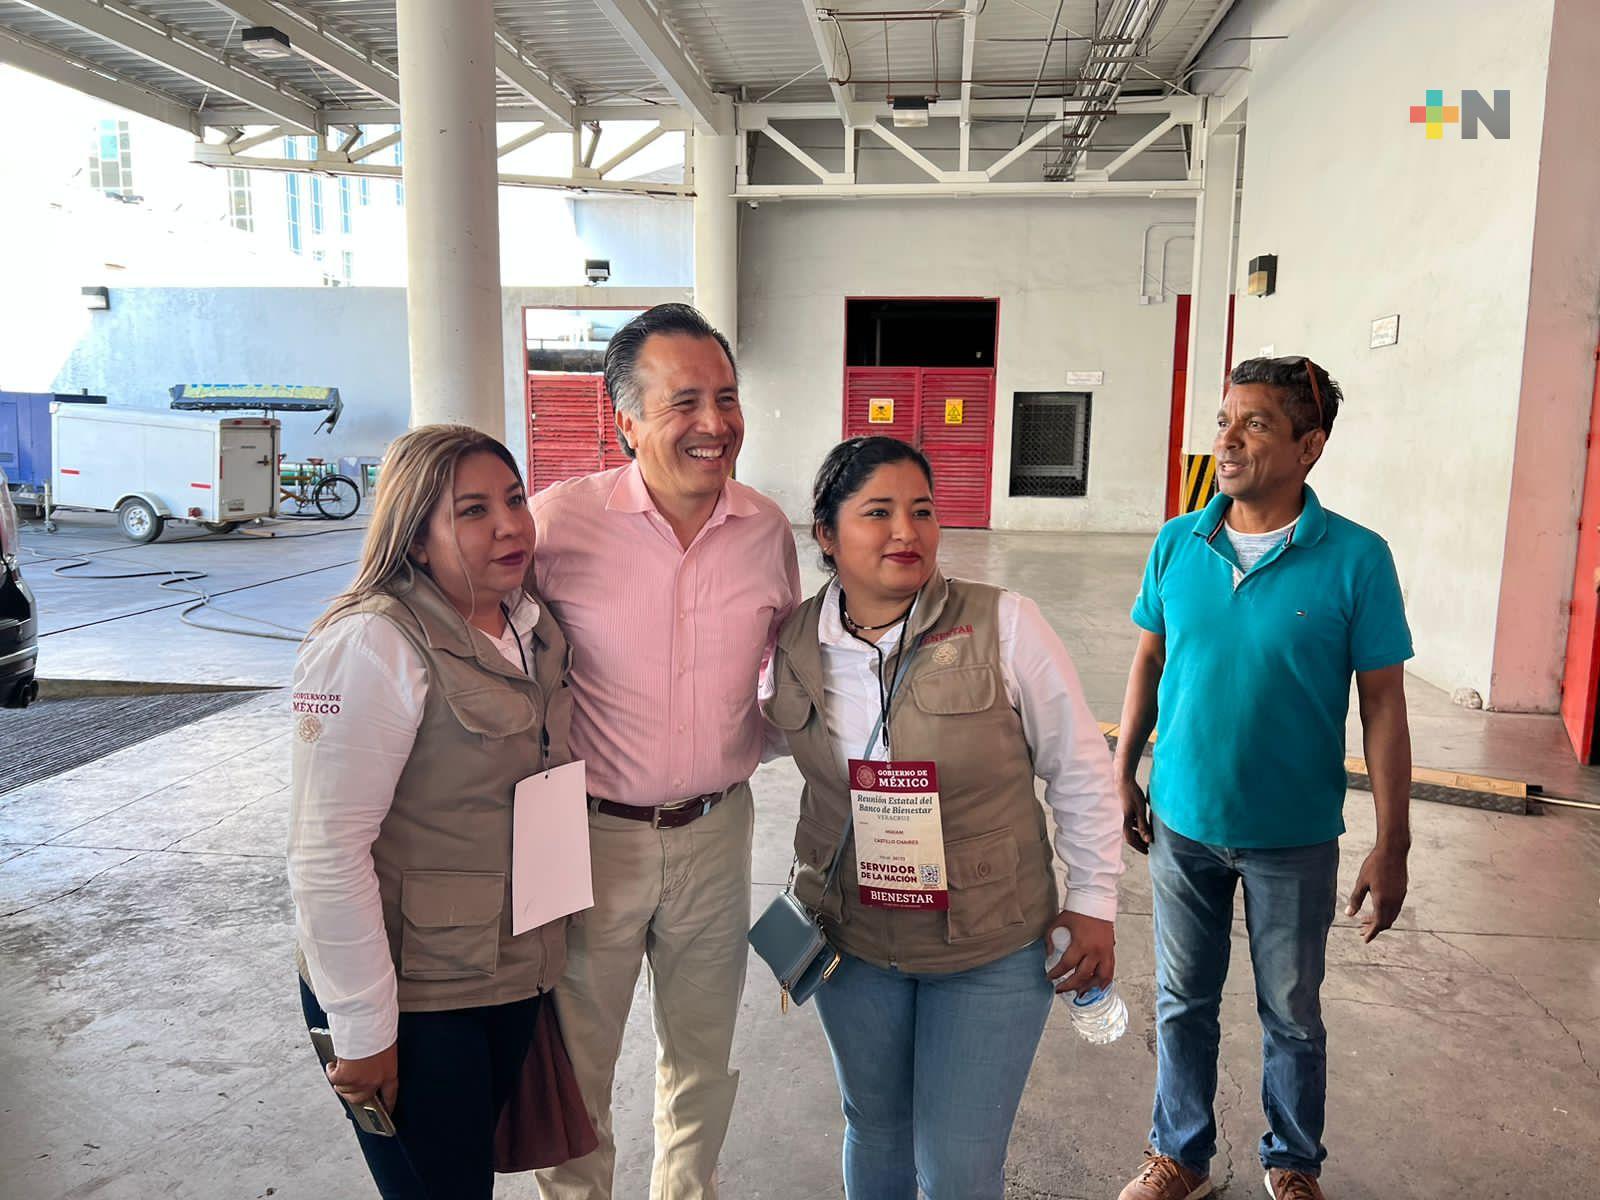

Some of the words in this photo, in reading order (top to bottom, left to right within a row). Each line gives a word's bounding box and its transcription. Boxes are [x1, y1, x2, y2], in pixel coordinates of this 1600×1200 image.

[293, 692, 327, 701] GOBIERNO
[293, 700, 340, 714] MÉXICO
[879, 775, 929, 788] MÉXICO
[888, 796, 918, 805] Estatal
[919, 796, 933, 805] del
[859, 804, 881, 813] Banco
[881, 806, 891, 814] de
[892, 806, 933, 815] Bienestar
[860, 861, 915, 874] SERVIDOR
[861, 871, 872, 879] DE
[872, 873, 883, 881] LA
[884, 874, 918, 884] NACIÓN
[871, 891, 934, 904] BIENESTAR
